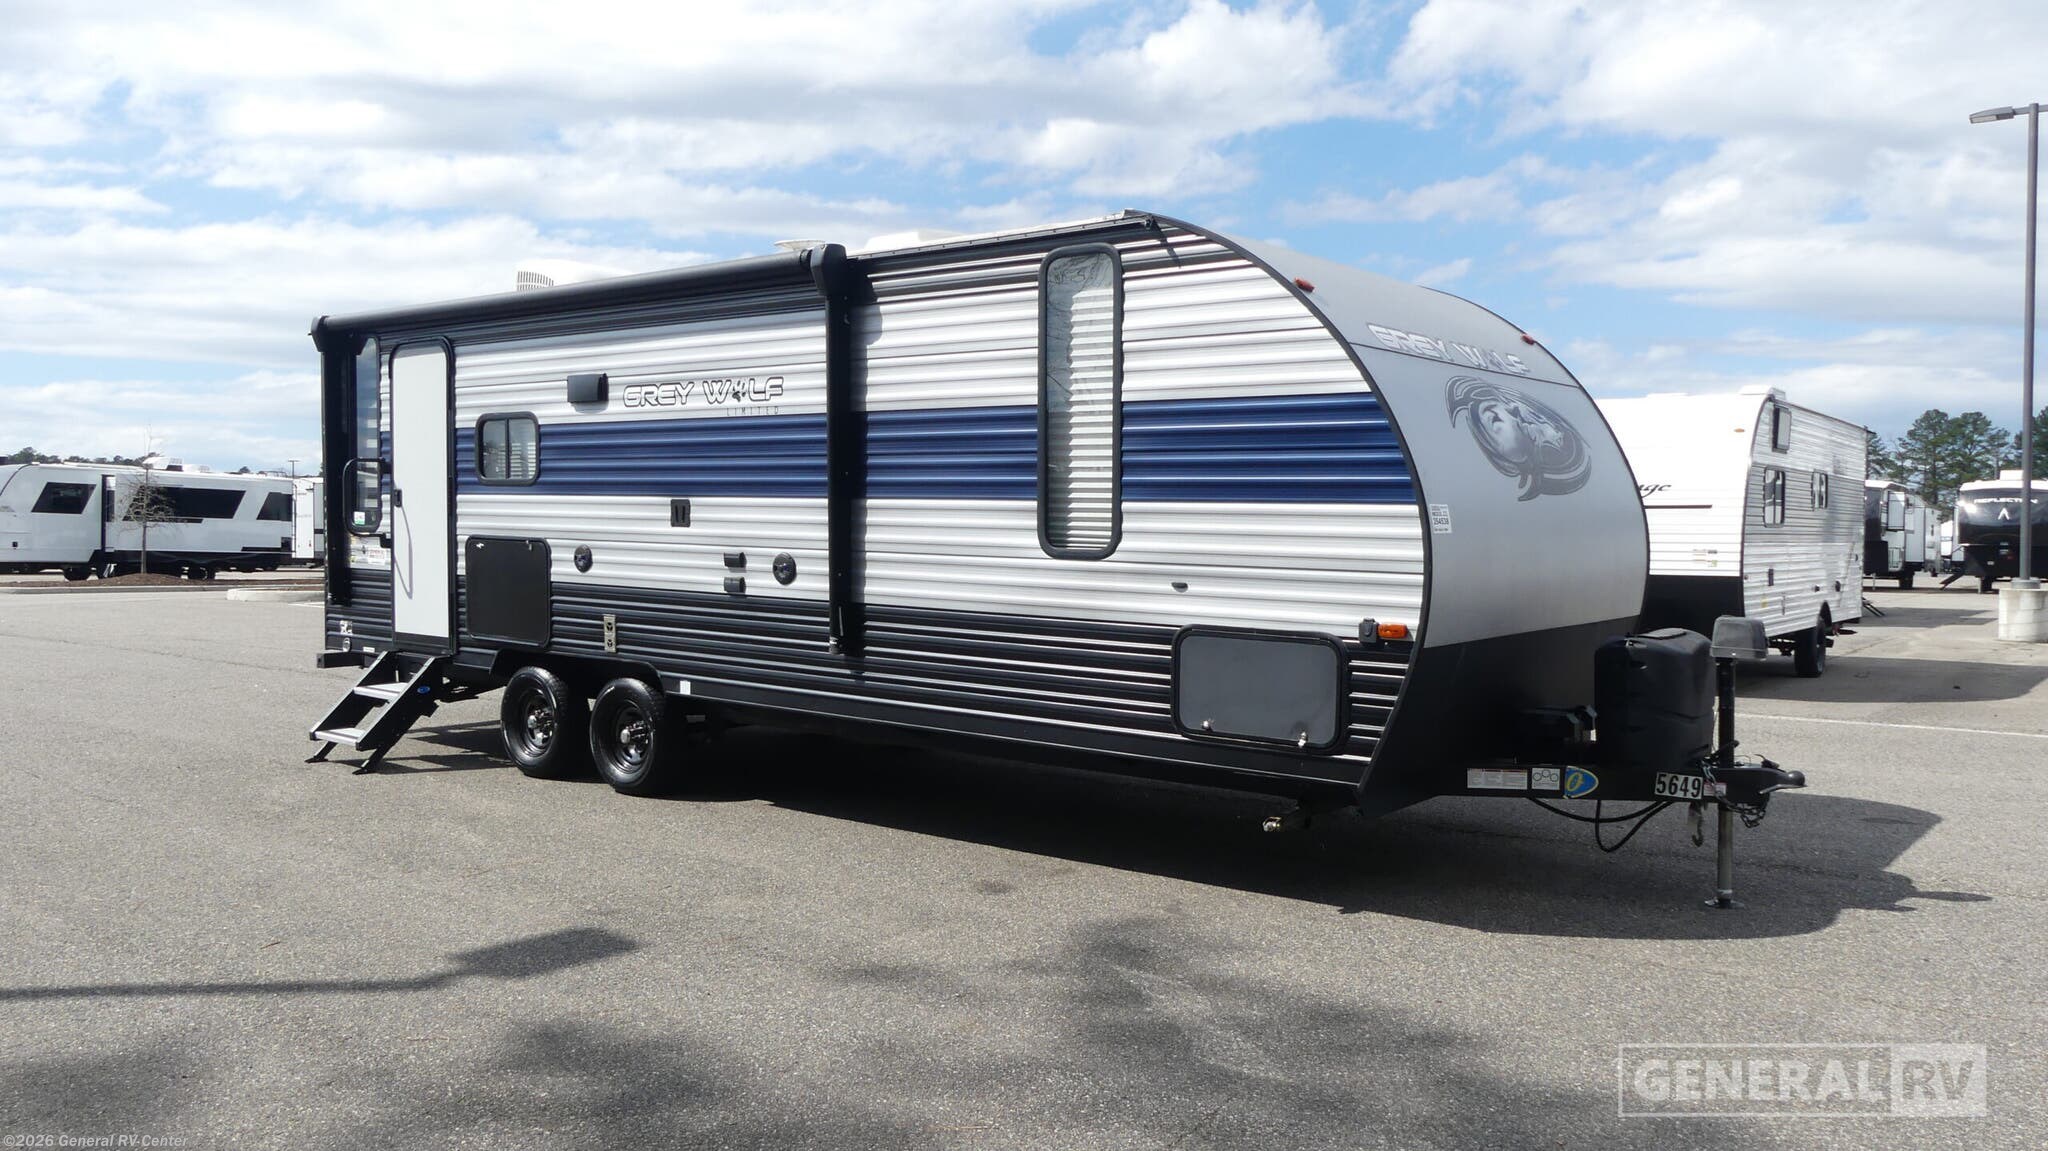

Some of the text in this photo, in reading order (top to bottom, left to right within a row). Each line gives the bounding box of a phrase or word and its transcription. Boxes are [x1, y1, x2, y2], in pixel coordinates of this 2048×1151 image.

[1366, 322, 1454, 362] GREY
[623, 376, 784, 407] GREY WOLF
[727, 406, 779, 416] LIMITED
[1656, 774, 1701, 798] 5649
